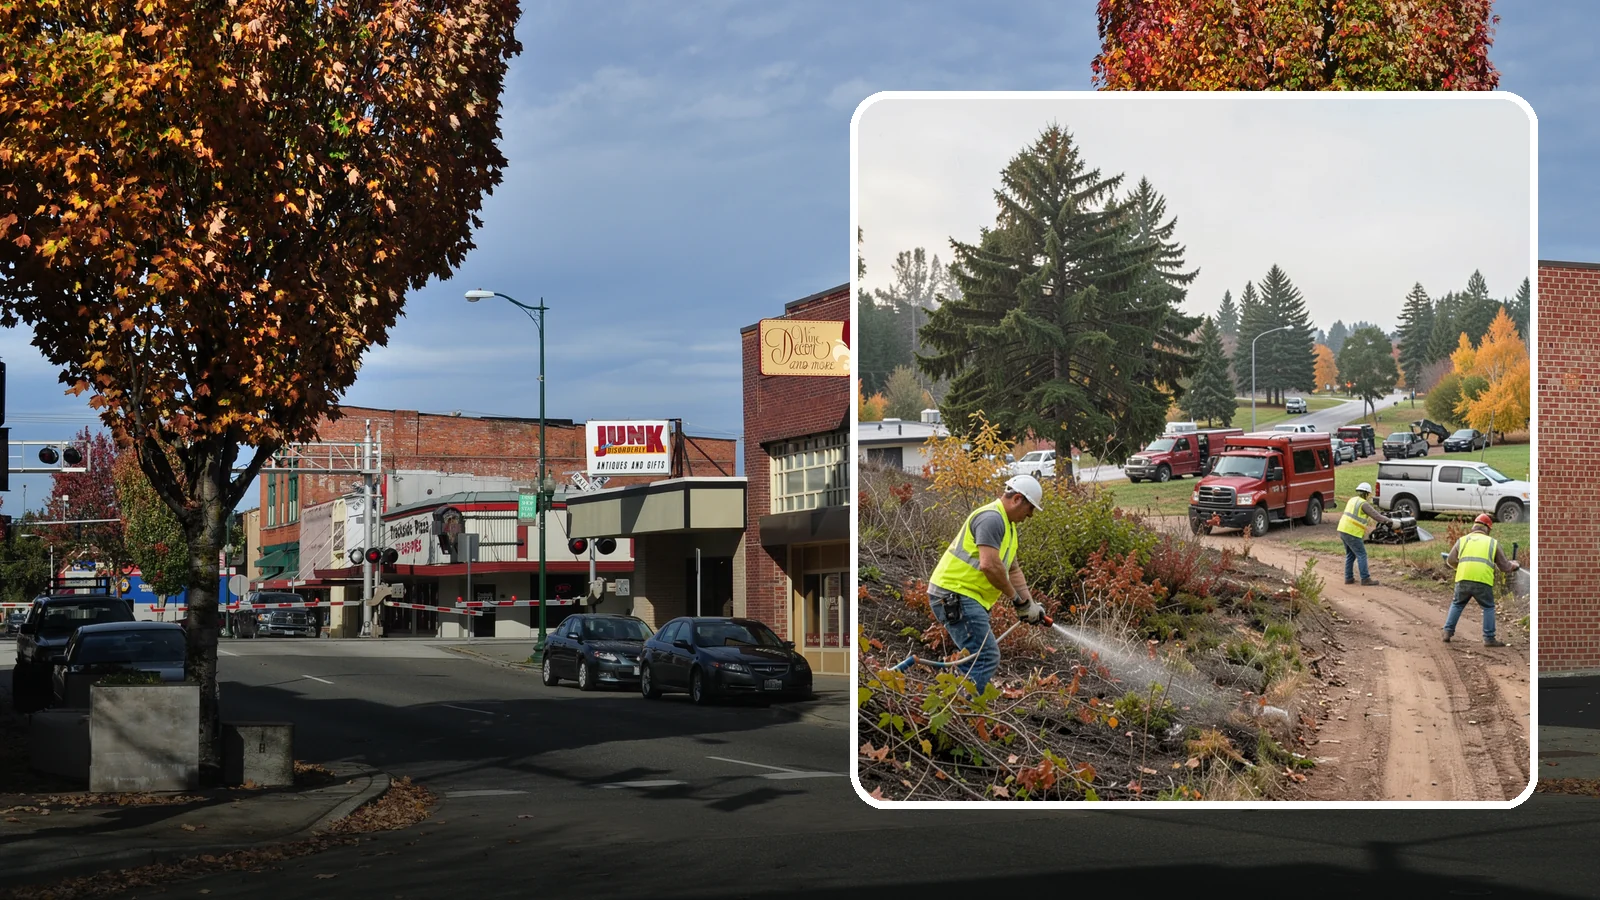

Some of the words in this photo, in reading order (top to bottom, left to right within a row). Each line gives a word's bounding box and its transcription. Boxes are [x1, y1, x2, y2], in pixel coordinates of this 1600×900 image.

[765, 328, 830, 365] Decor
[595, 425, 665, 457] JUNK
[607, 446, 646, 454] DISORDERLY
[596, 461, 628, 470] ANTIQUES
[631, 461, 643, 470] AND
[646, 460, 665, 470] GIFTS
[573, 473, 587, 491] RAIL
